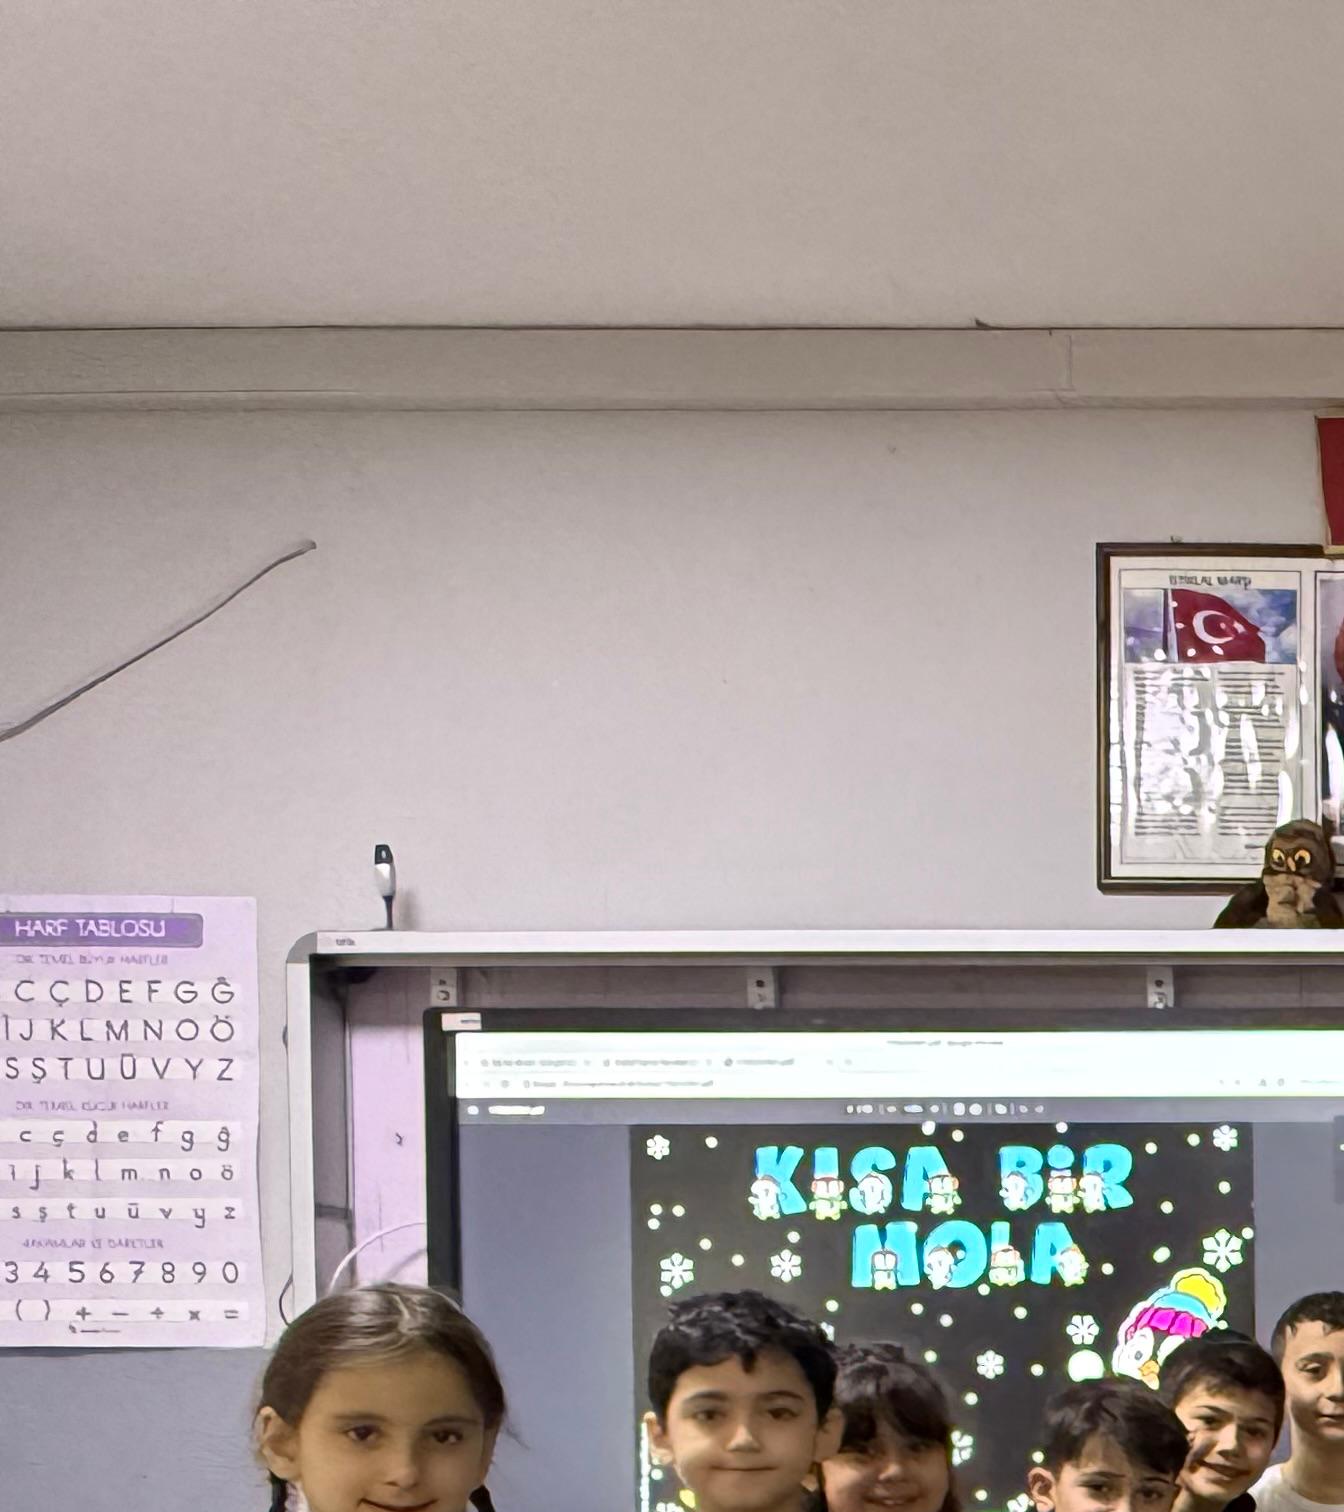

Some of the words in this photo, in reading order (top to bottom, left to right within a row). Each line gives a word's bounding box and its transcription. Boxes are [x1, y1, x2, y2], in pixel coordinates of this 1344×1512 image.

[15, 920, 69, 937] HARF
[76, 919, 166, 938] TABLOSU
[748, 1144, 961, 1221] KISA
[4, 1261, 19, 1283] 3
[33, 1261, 50, 1283] 4
[69, 1261, 85, 1283] 5
[99, 1261, 115, 1283] 6
[129, 1261, 146, 1283] 7
[162, 1261, 175, 1283] 8
[192, 1261, 206, 1283] 9
[222, 1261, 239, 1283] 0
[850, 1219, 1087, 1288] MOLA
